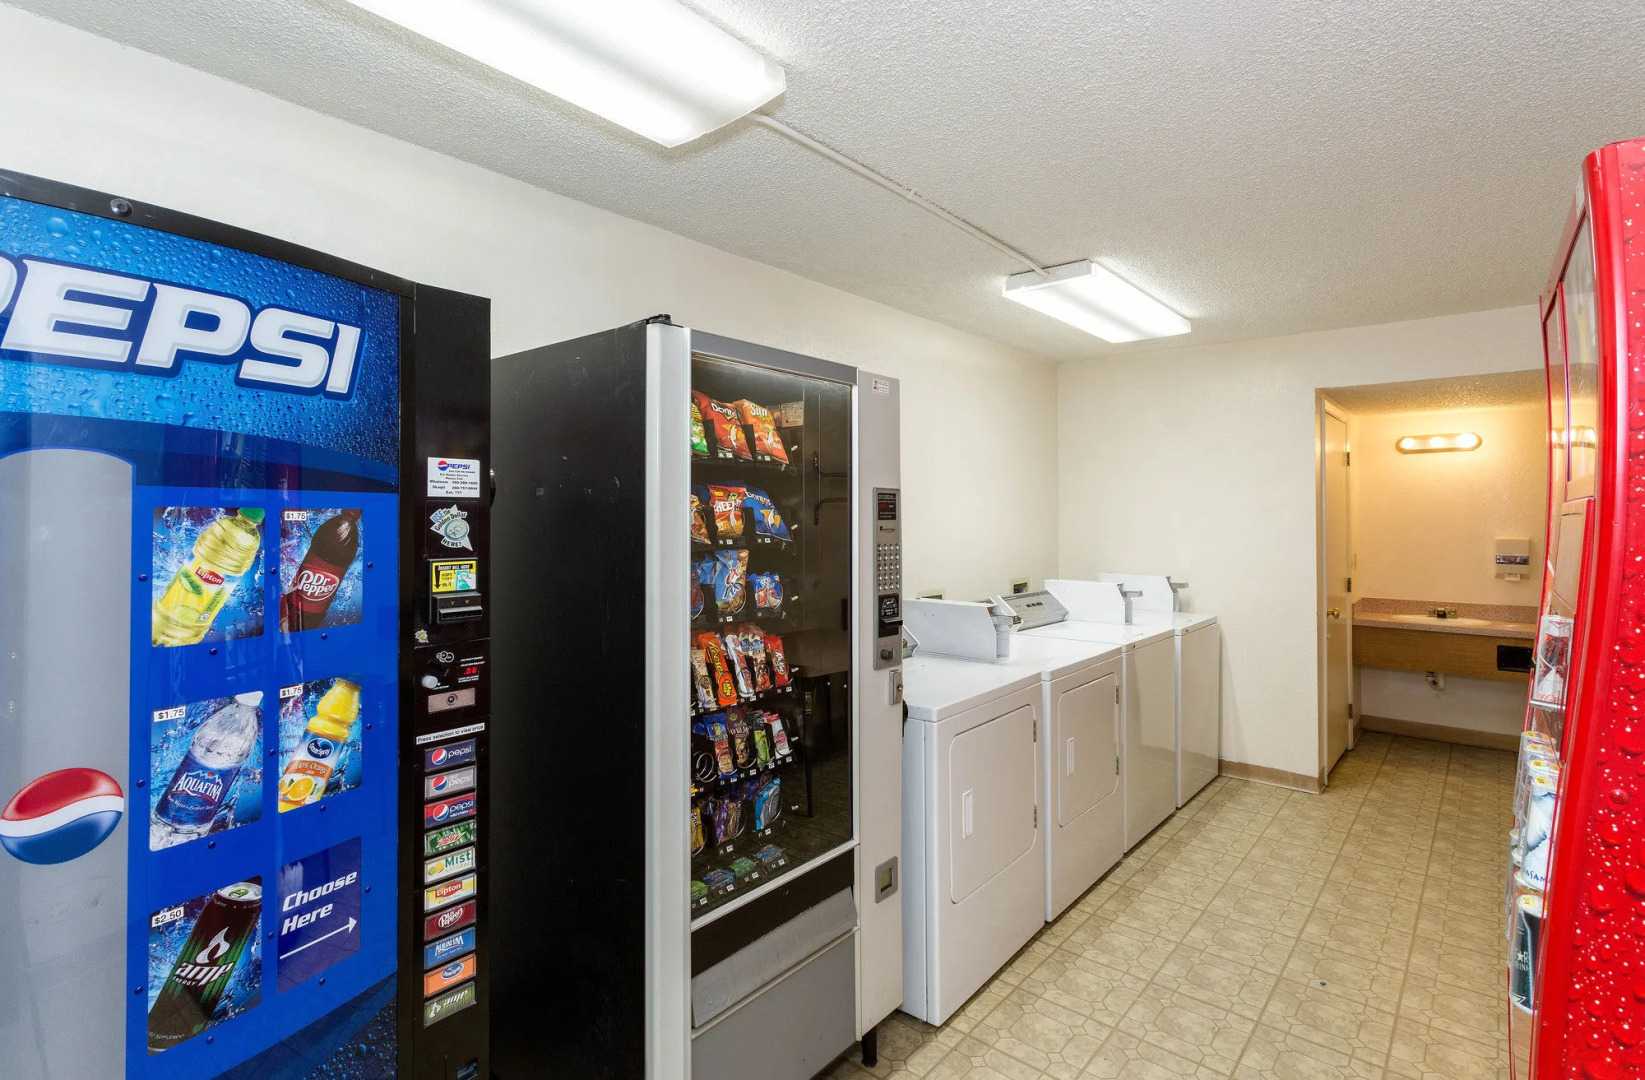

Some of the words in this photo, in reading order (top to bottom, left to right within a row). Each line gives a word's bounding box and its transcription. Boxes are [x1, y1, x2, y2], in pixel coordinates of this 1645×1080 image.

[0, 256, 361, 394] EPSI
[750, 403, 768, 417] Sun
[286, 512, 306, 520] $1.75
[431, 510, 444, 523] USE
[434, 517, 451, 531] Golden
[450, 511, 467, 519] Dollar
[442, 539, 462, 547] HERE!
[196, 567, 223, 584] Lipton
[314, 573, 330, 586] Dr
[298, 570, 337, 597] Pepper
[281, 687, 302, 697] $1.75
[158, 708, 185, 720] $1.75
[432, 732, 454, 740] selection
[448, 745, 472, 758] pepsi
[172, 772, 223, 803] AQUAFINA
[448, 774, 472, 787] pepsi
[449, 799, 473, 814] pepsi
[445, 852, 471, 868] Mist
[283, 871, 358, 912] Choose
[437, 884, 461, 896] Lipton
[154, 909, 182, 925] $2.50
[281, 903, 333, 936] Here
